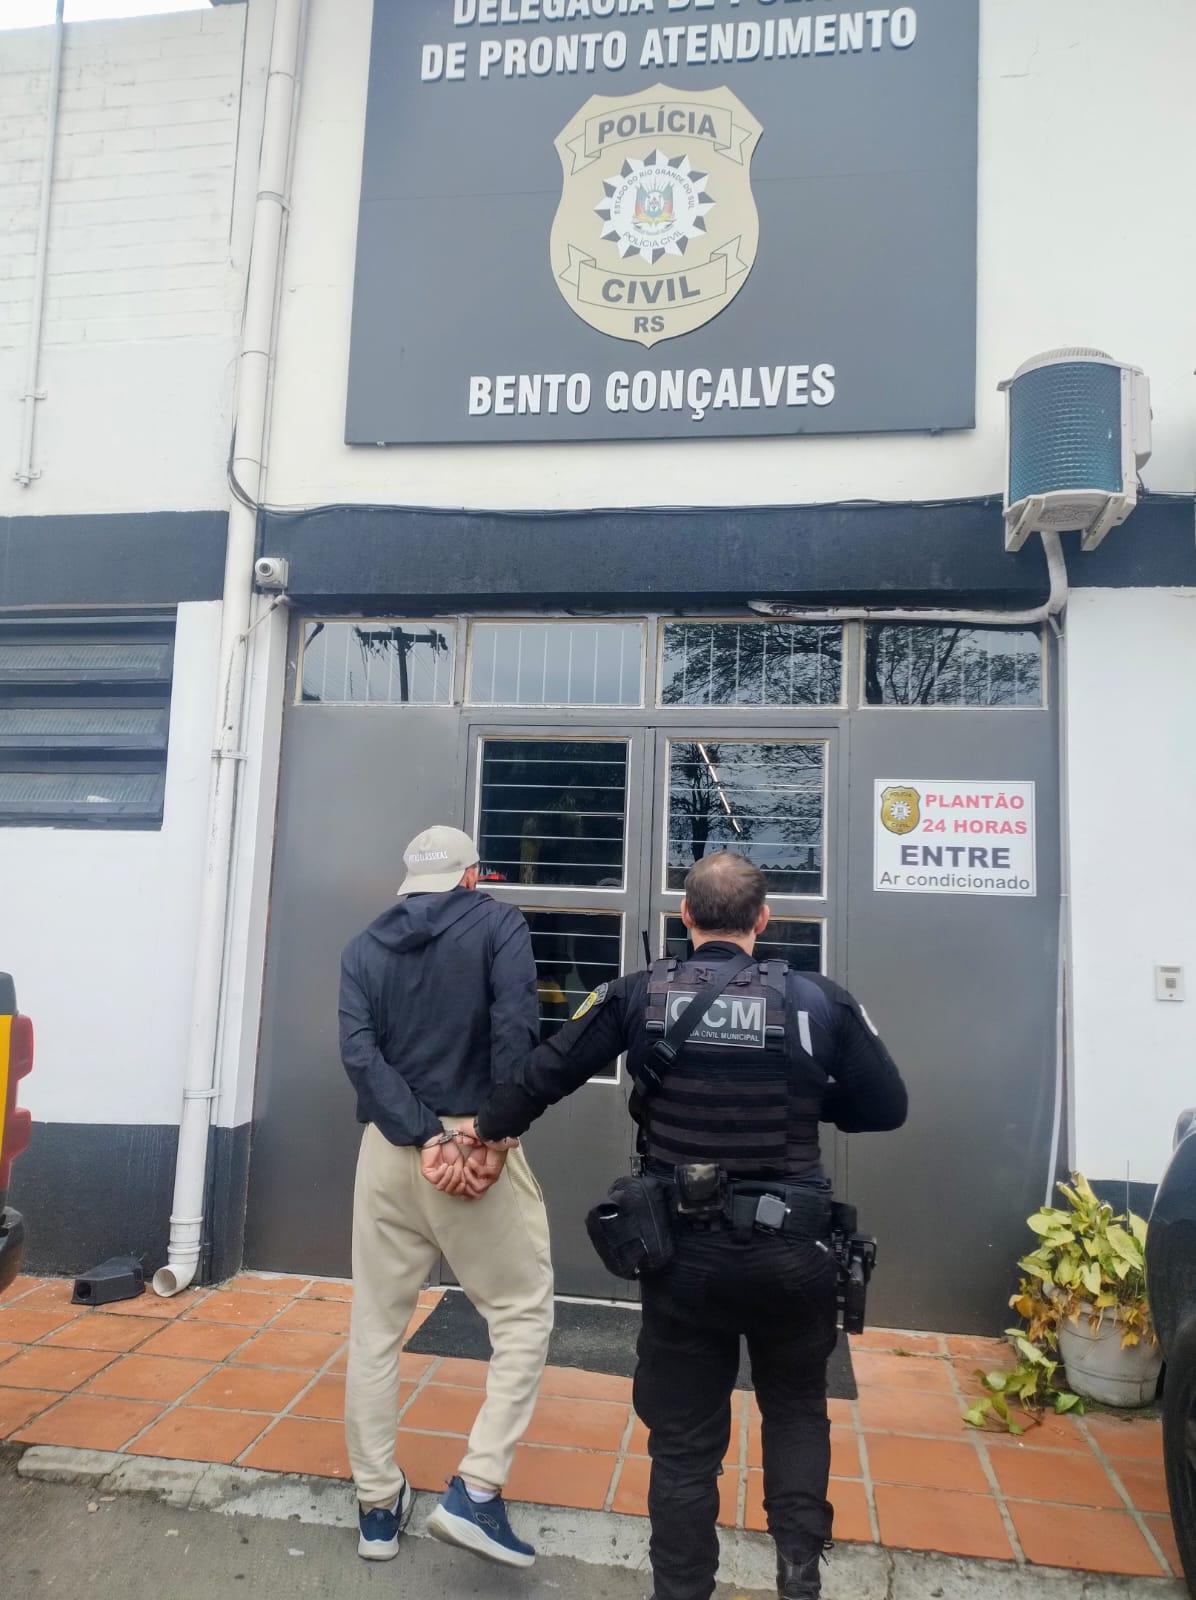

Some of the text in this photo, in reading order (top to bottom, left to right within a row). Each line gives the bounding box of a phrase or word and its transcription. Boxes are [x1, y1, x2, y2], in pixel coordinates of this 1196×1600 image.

[453, 0, 654, 26] DELEG
[420, 7, 917, 80] DE PRONTO ATENDIMENTO
[598, 105, 717, 144] POLÍCIA
[655, 168, 685, 184] GRANDE
[601, 275, 701, 304] CIVIL
[633, 315, 665, 333] RS
[468, 363, 836, 421] BENTO GONÇALVES
[925, 793, 1025, 810] PLANTÃO
[922, 819, 946, 833] 24
[953, 819, 1027, 835] HORAS
[900, 844, 1011, 869] ENTRE
[880, 871, 1030, 890] Ar condicionado
[701, 1030, 719, 1039] CIVIL
[720, 1032, 760, 1042] MUNICIPAL
